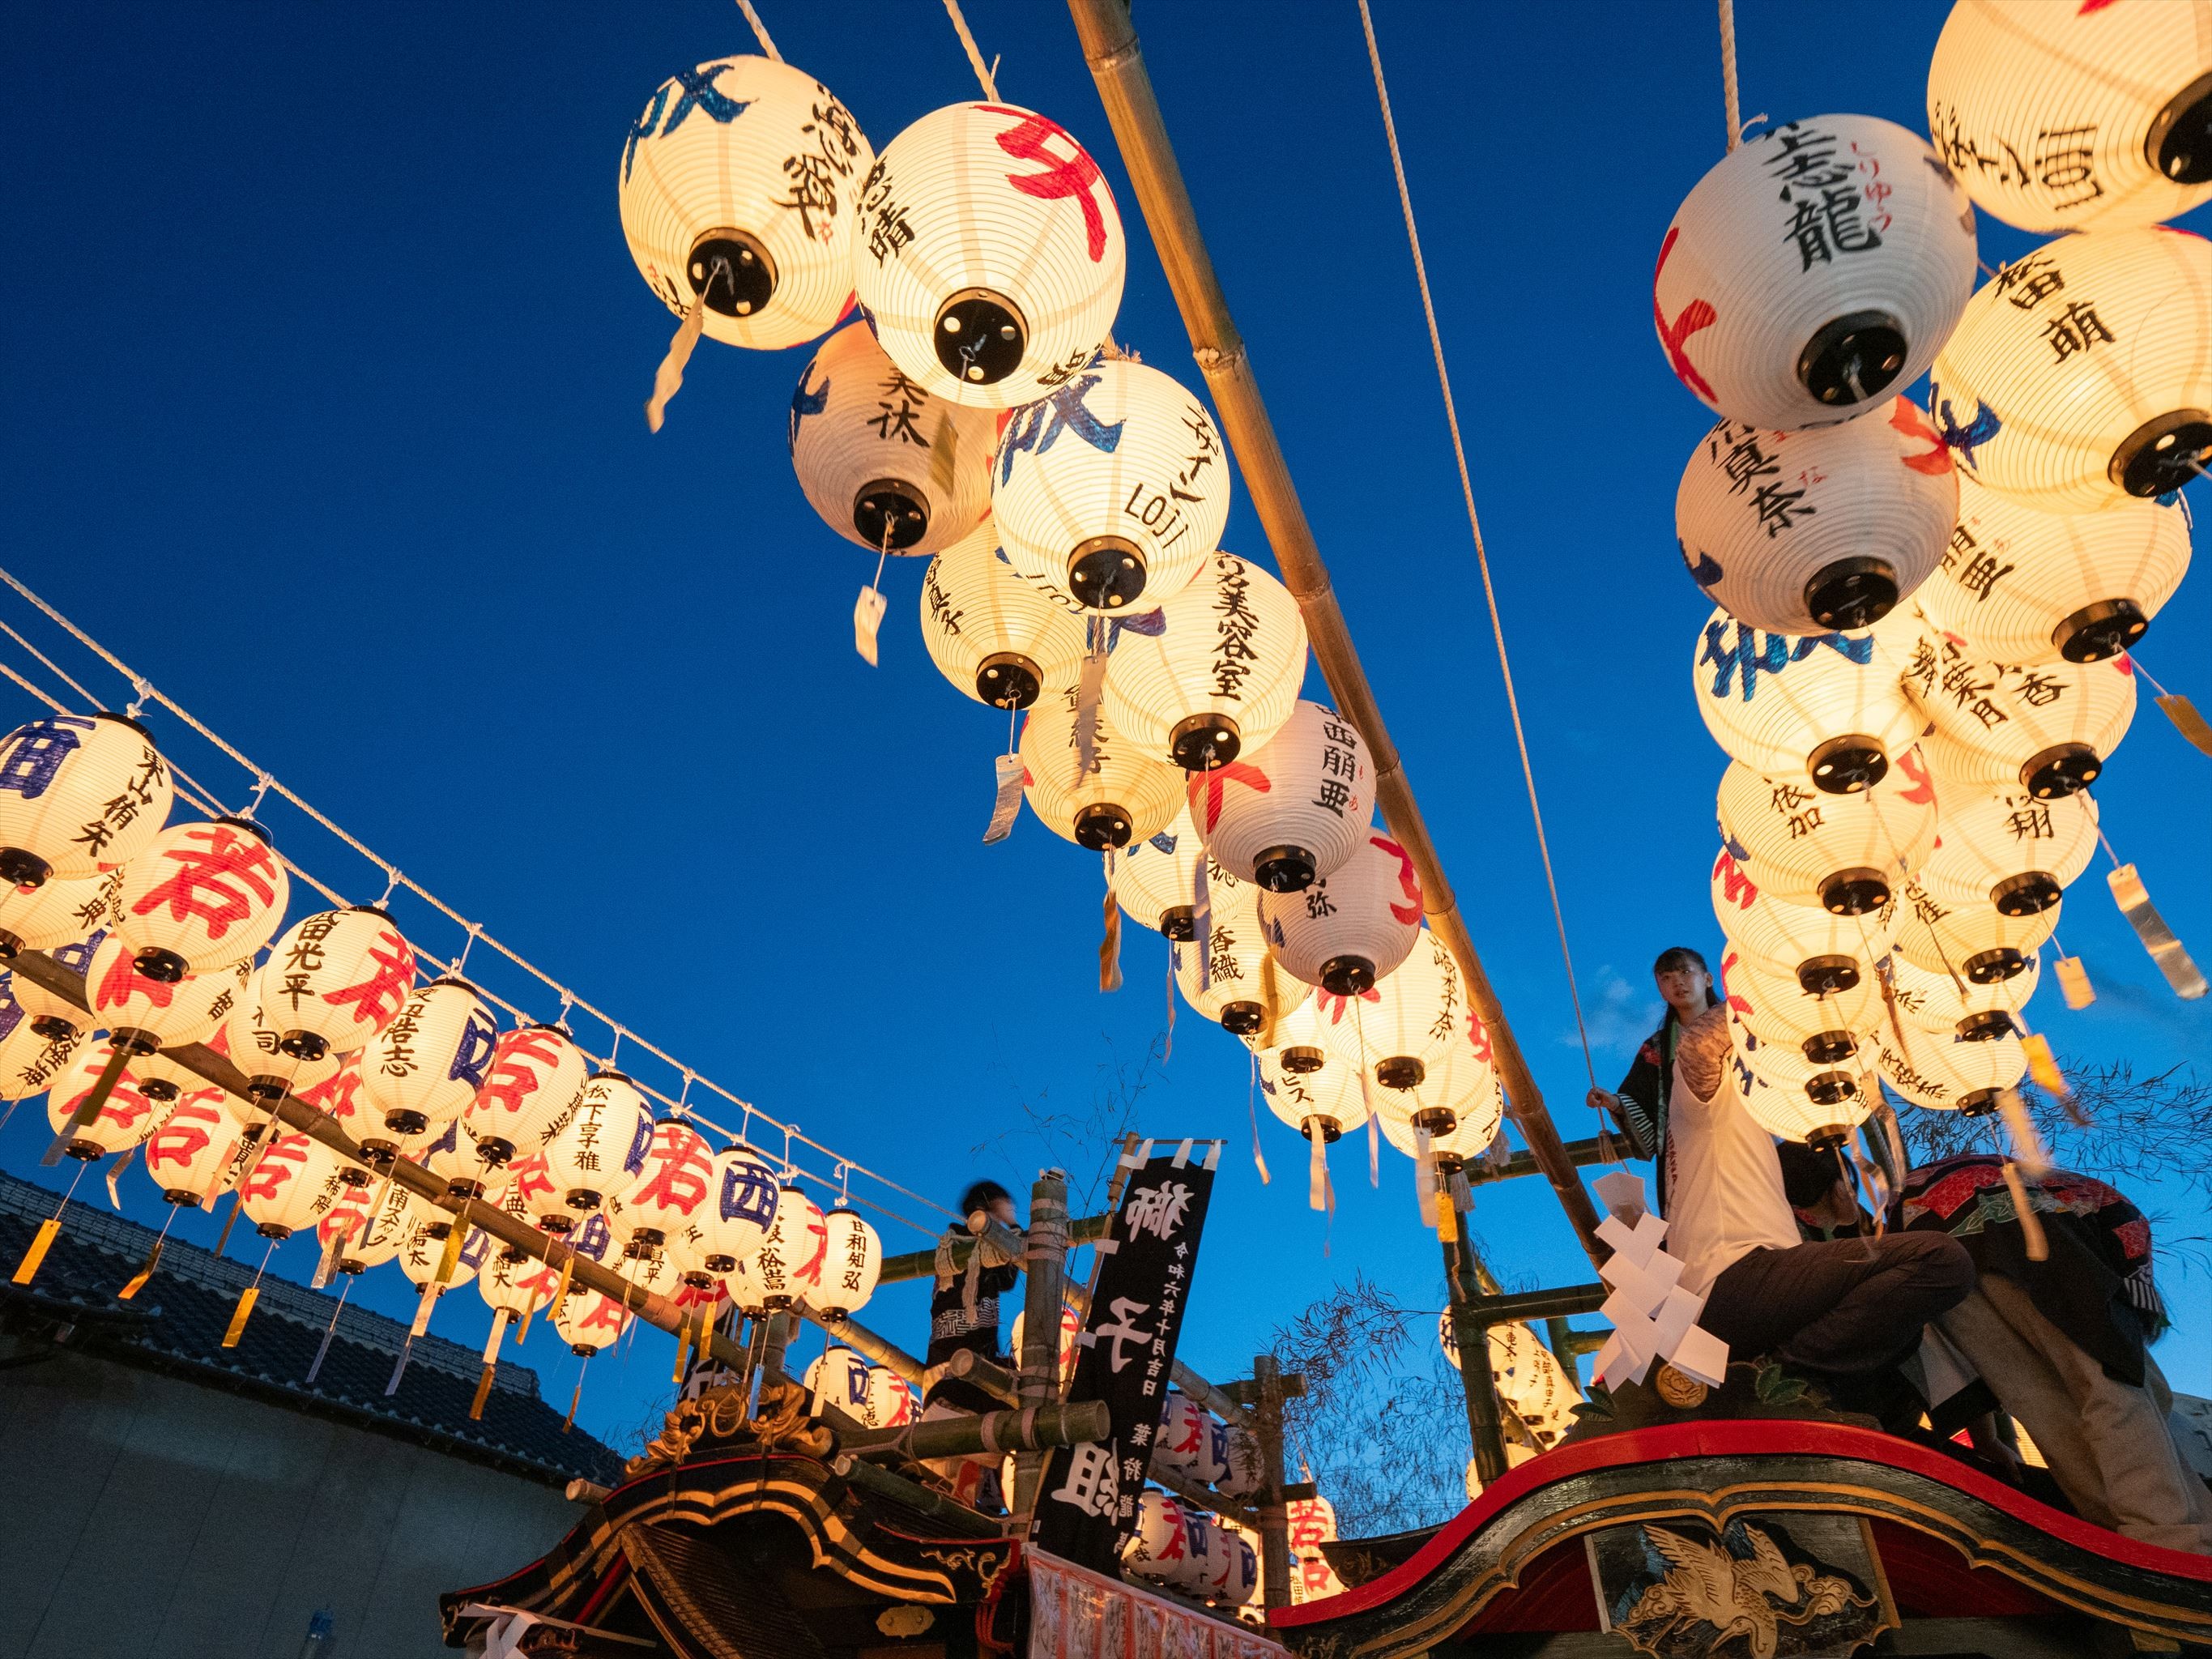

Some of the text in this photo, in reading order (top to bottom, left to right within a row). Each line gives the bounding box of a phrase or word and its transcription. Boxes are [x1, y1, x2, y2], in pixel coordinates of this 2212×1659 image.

[130, 825, 276, 941] 若
[320, 928, 419, 1040] 若
[1208, 924, 1246, 983] 香織
[631, 1126, 714, 1217] 若
[718, 1159, 780, 1235] 西
